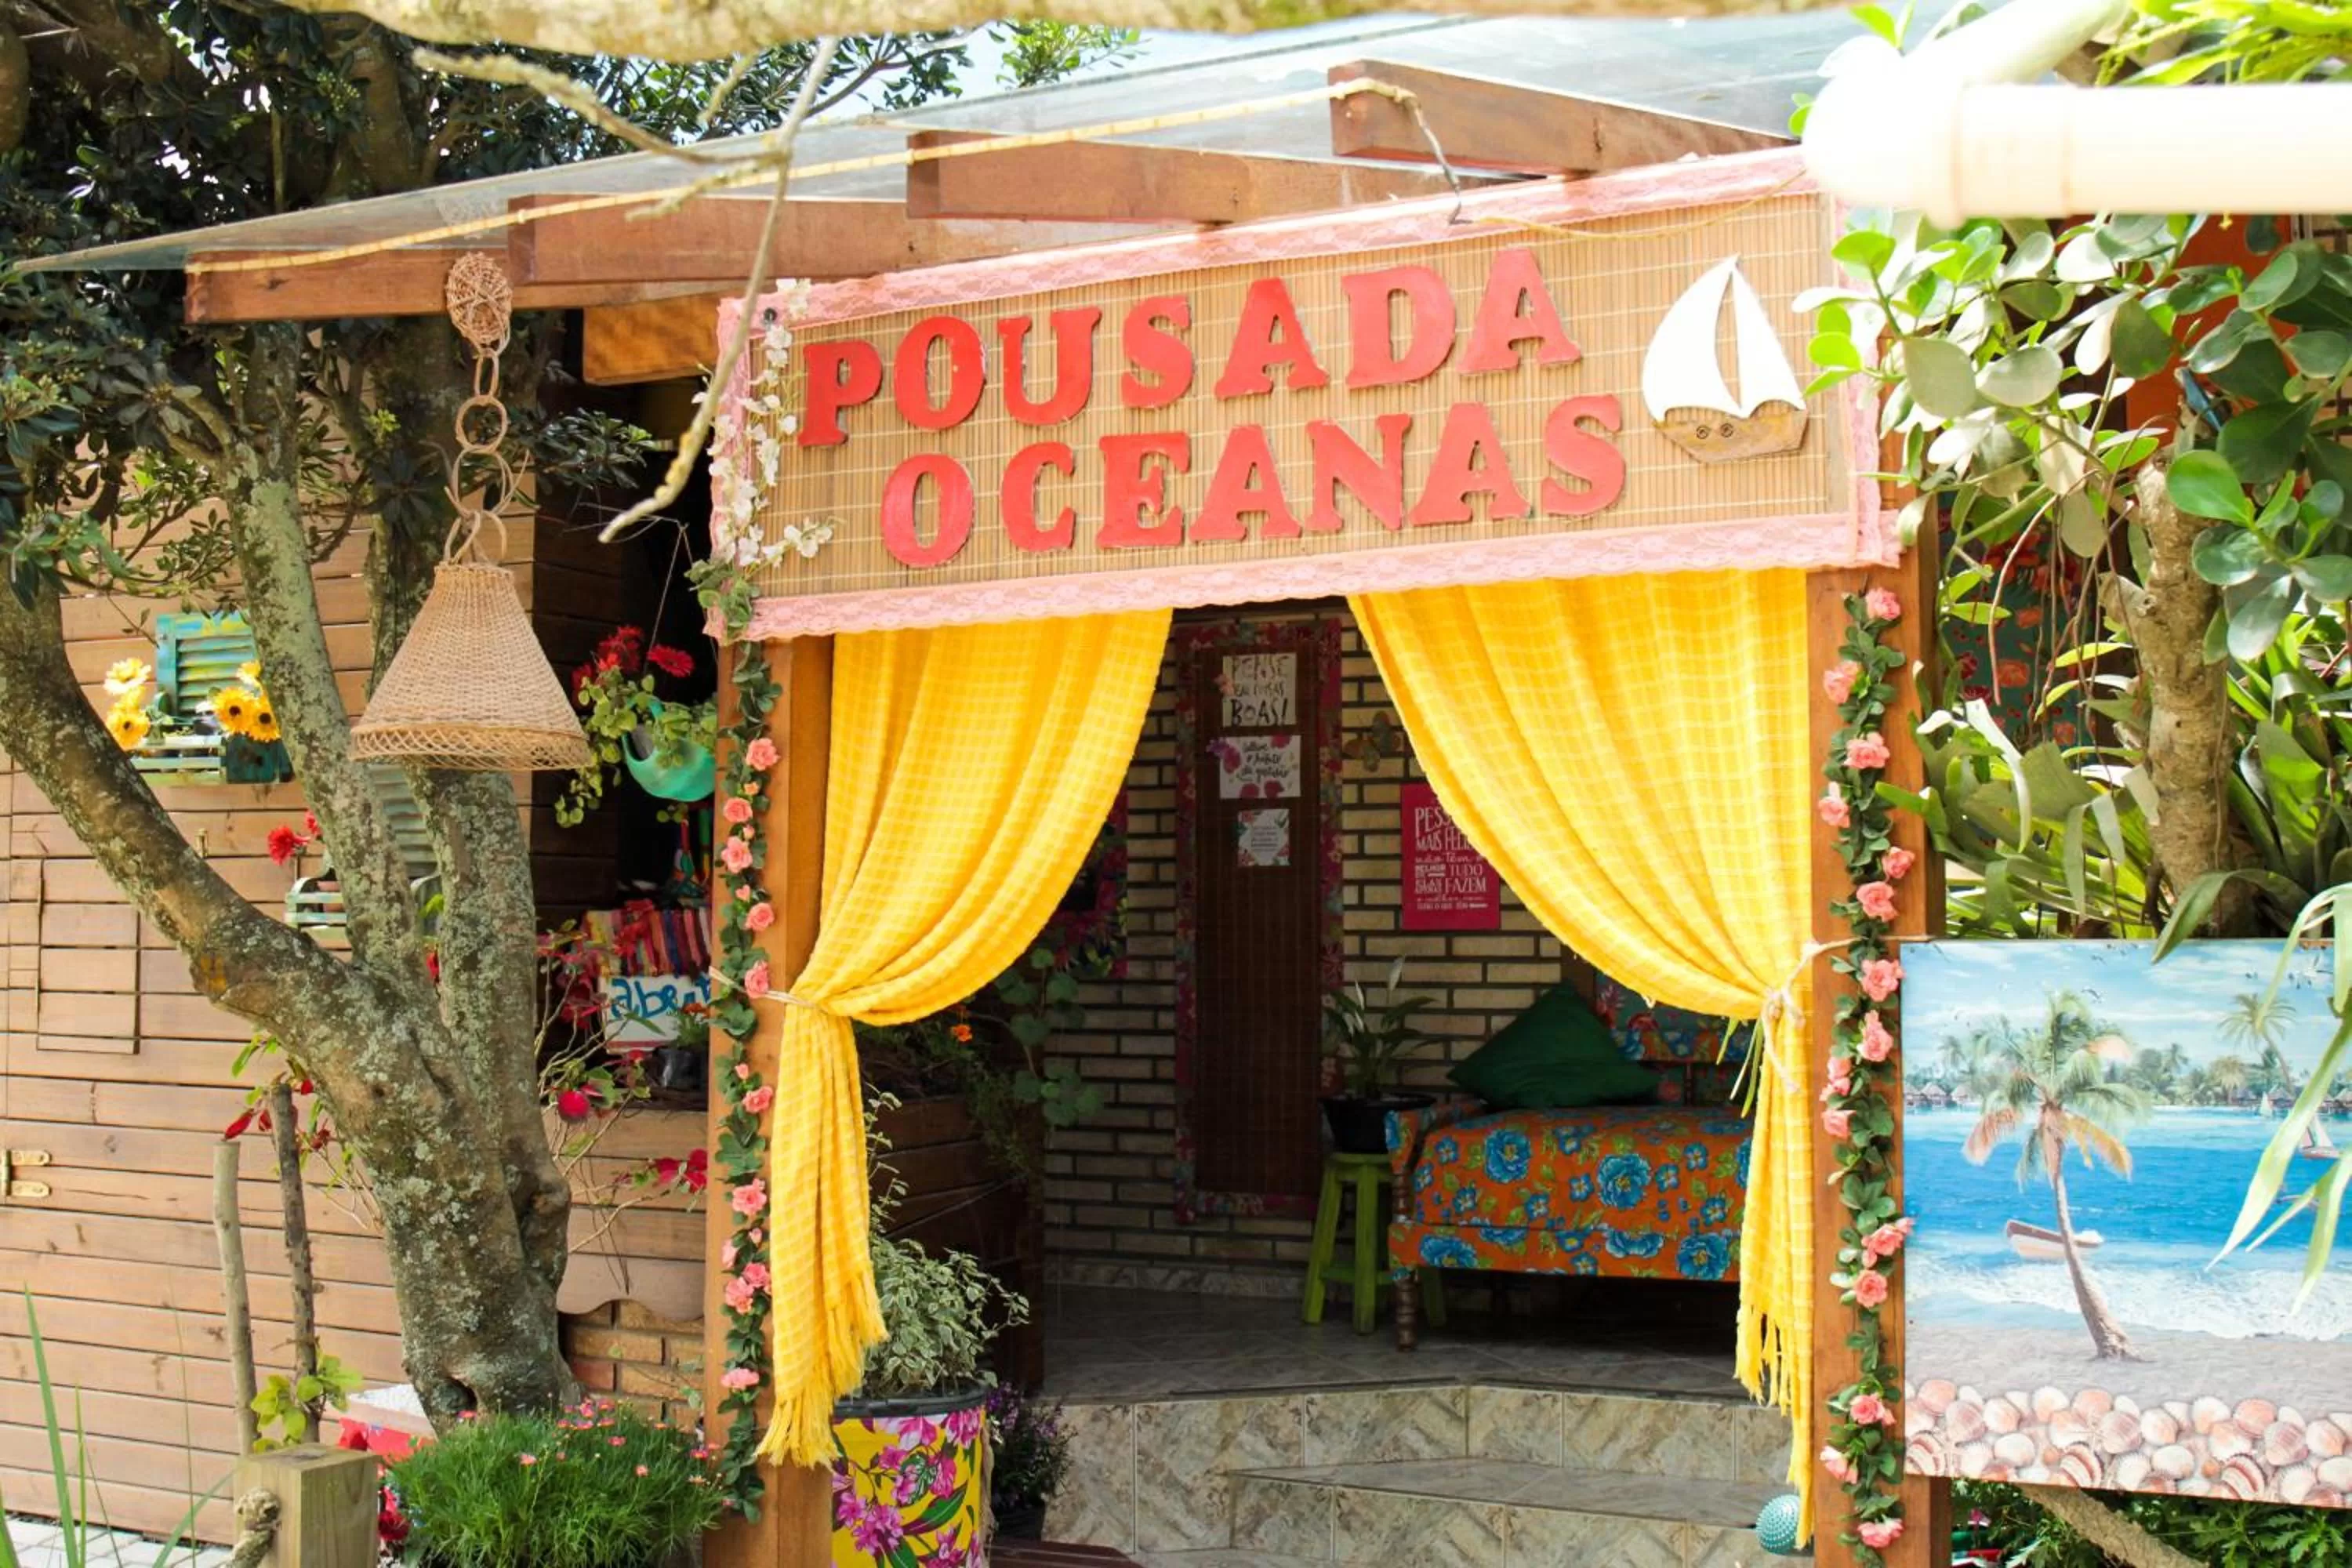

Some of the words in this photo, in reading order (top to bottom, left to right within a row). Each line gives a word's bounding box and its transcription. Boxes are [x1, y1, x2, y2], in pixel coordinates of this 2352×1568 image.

[796, 246, 1582, 449] POUSADA
[880, 394, 1627, 568] OCEANAS
[1444, 826, 1469, 851] FELI
[1448, 863, 1483, 877] TUDO
[1444, 877, 1487, 894] FAZEM
